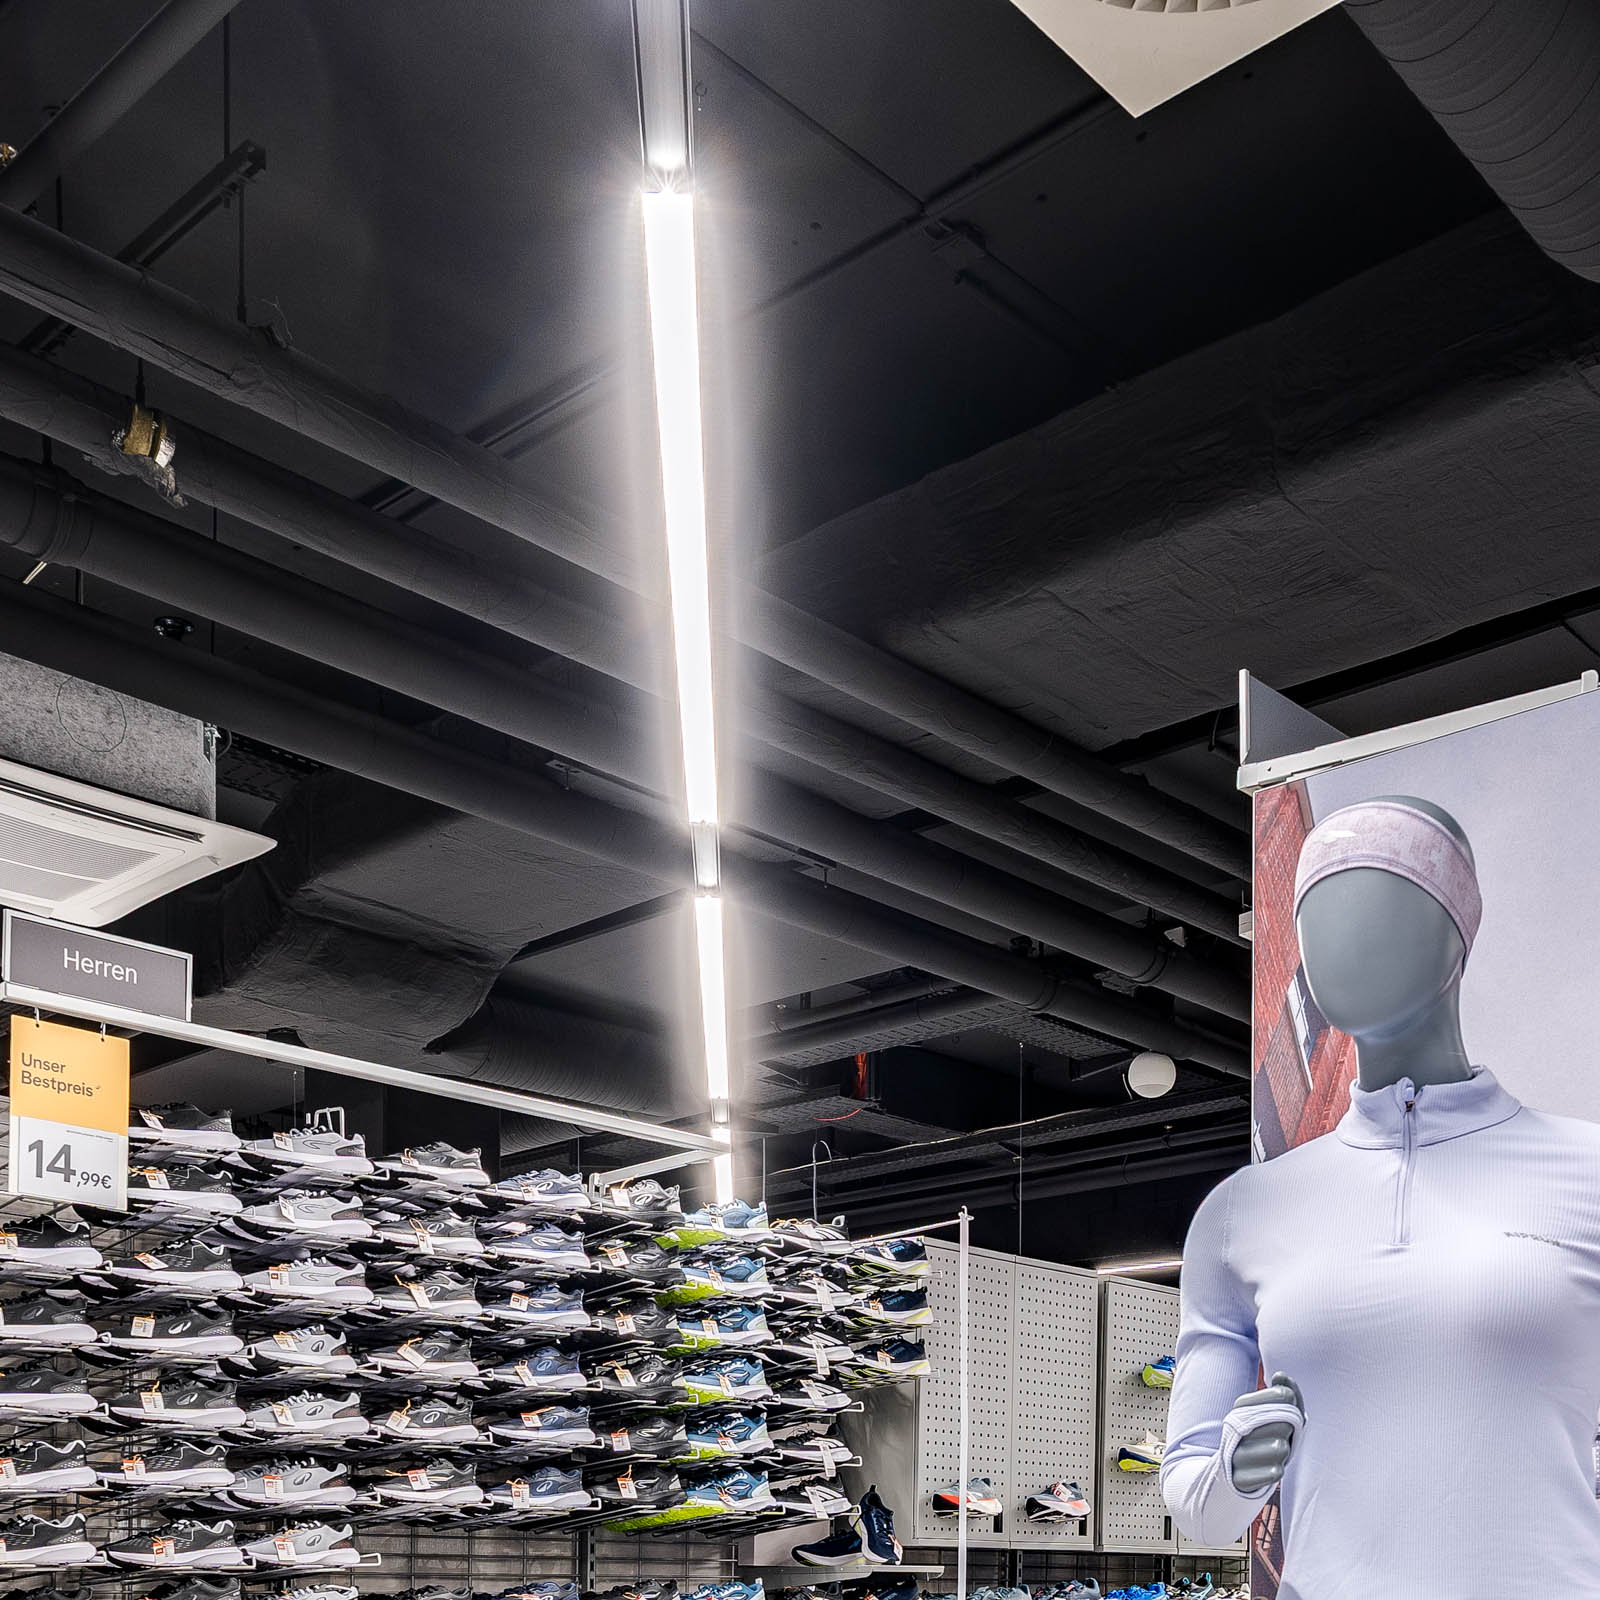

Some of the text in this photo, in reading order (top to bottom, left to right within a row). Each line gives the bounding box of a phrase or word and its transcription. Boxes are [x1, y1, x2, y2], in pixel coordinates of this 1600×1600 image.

[63, 947, 138, 985] Herren
[21, 1052, 66, 1074] Unser
[21, 1070, 94, 1097] Bestpreis
